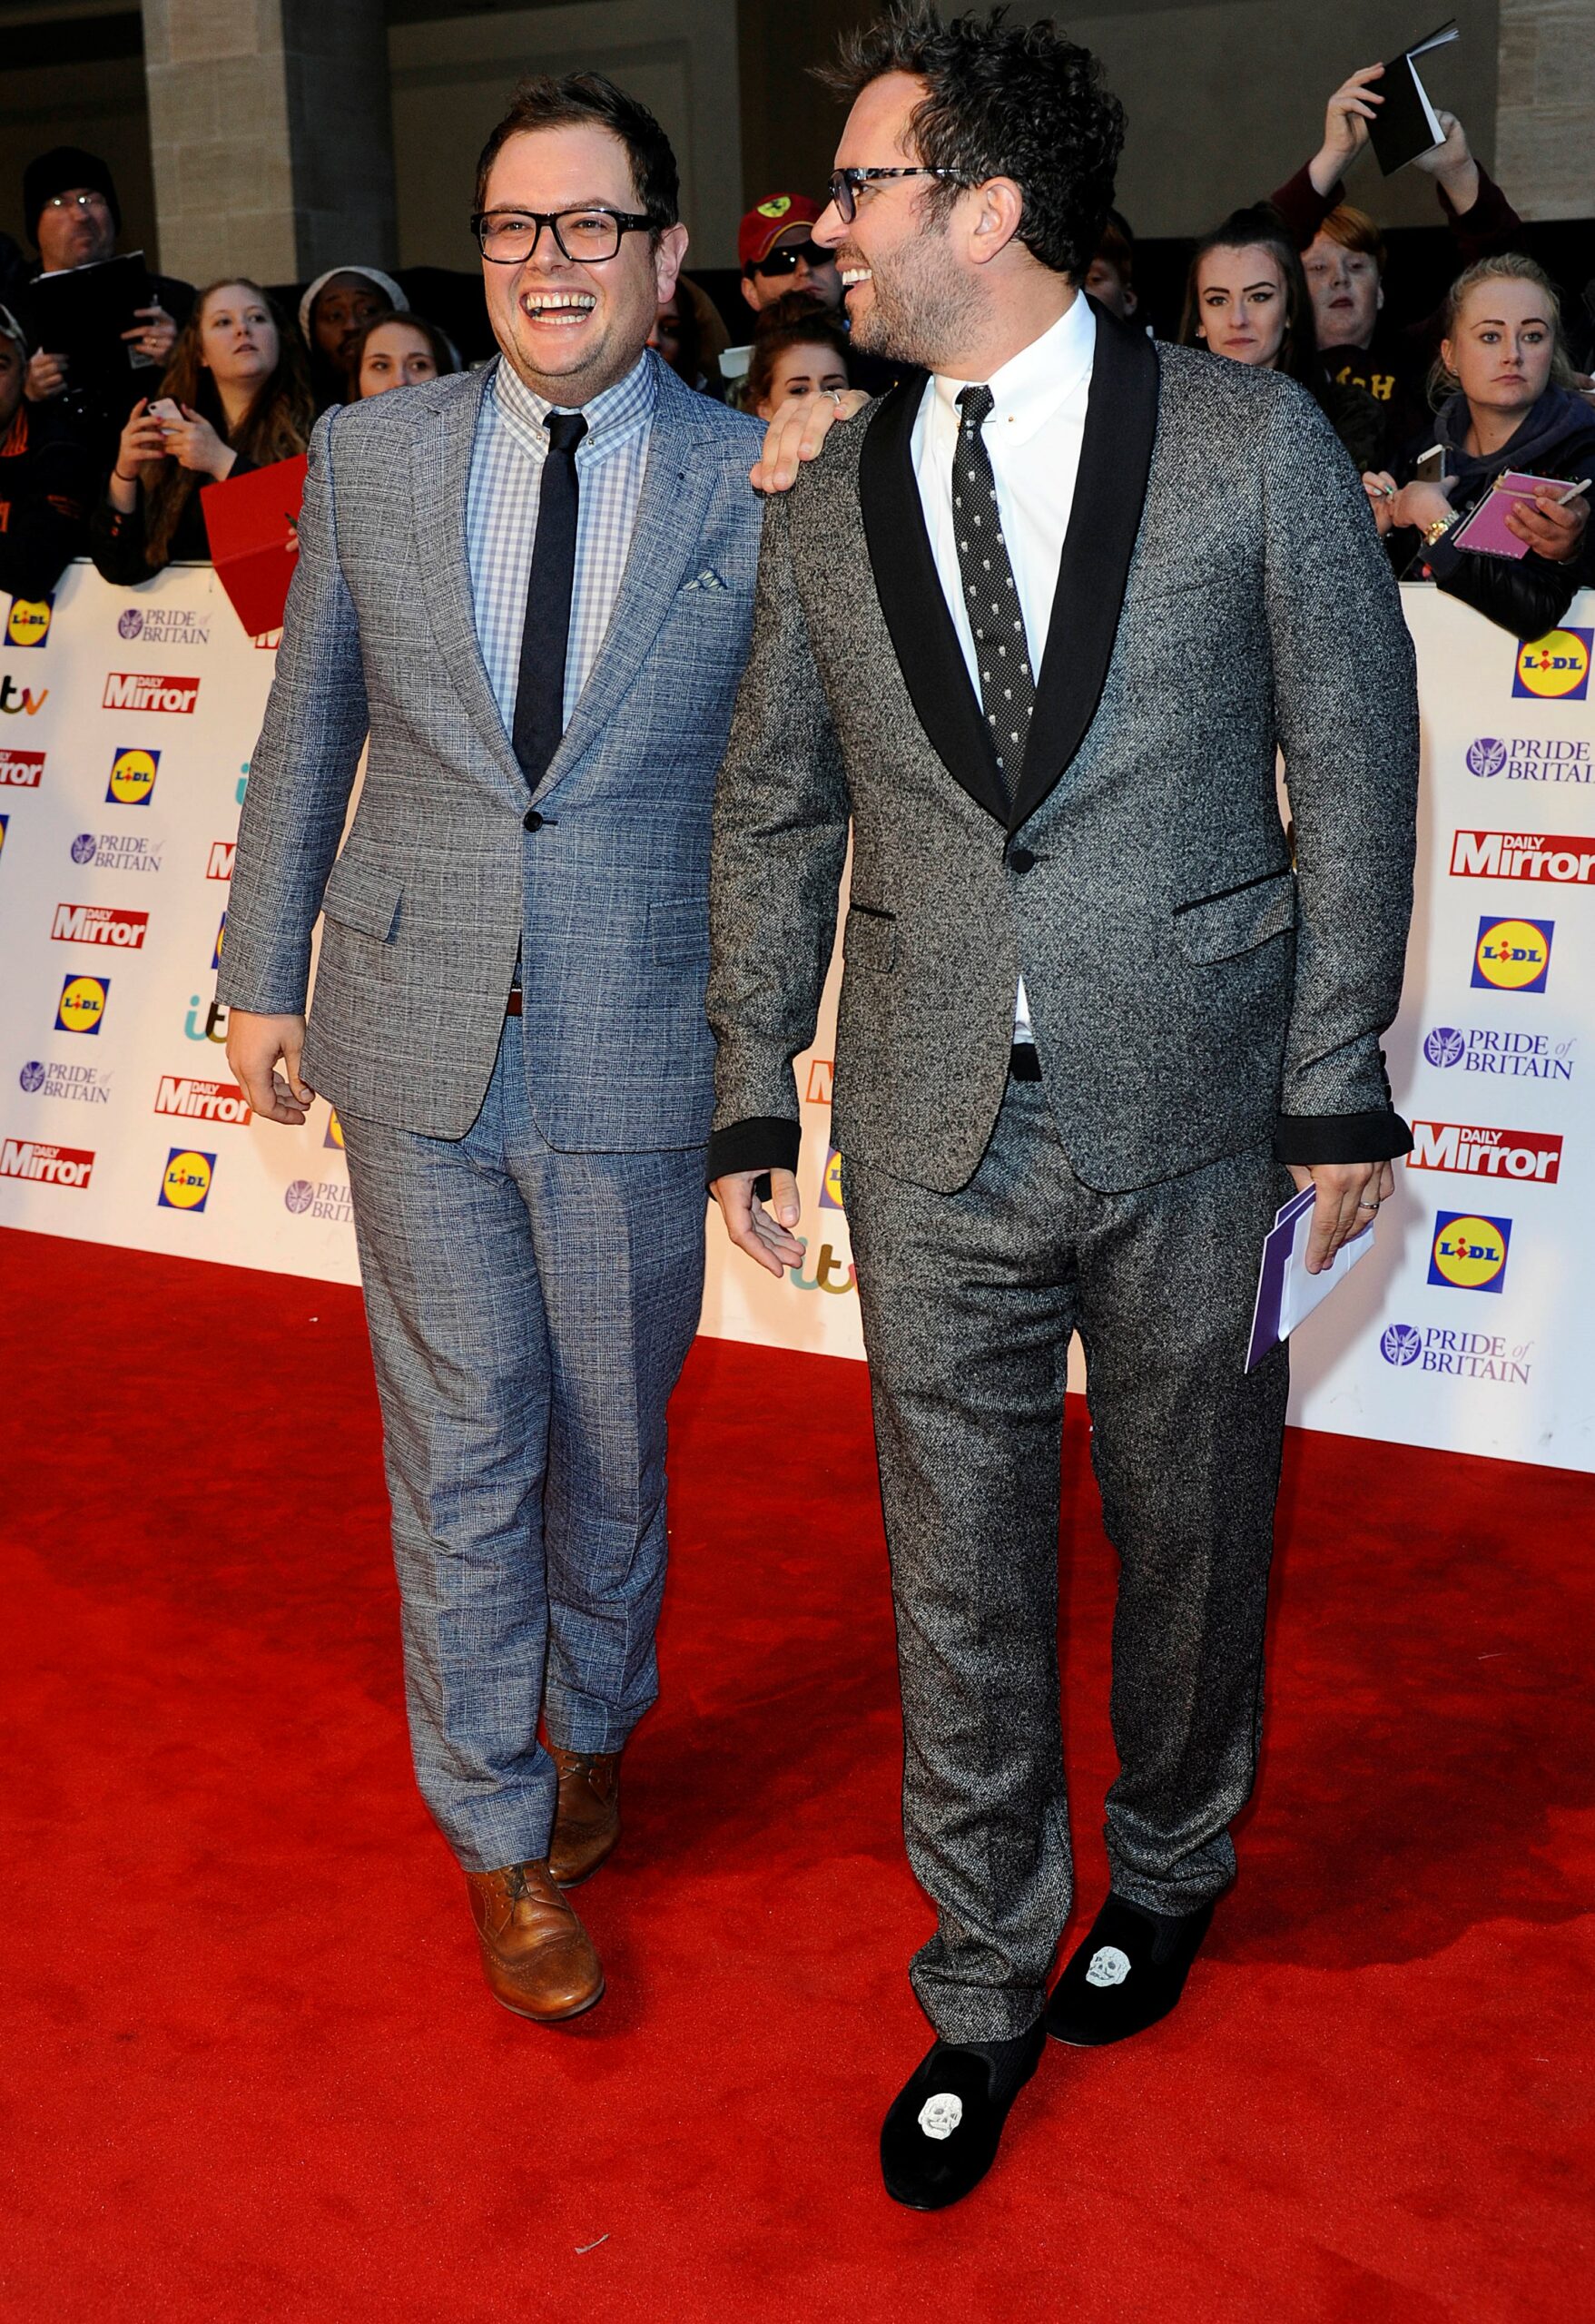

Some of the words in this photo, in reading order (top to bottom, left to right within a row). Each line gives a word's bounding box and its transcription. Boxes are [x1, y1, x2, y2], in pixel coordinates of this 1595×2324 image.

[145, 609, 196, 626] PRIDE
[142, 625, 210, 644] BRITAIN
[137, 676, 163, 687] DAILY
[0, 675, 49, 715] tv
[104, 675, 196, 712] Mirror
[1510, 739, 1590, 761] PRIDE
[1506, 761, 1595, 783] BRITAI
[98, 835, 149, 853] PRIDE
[1503, 835, 1544, 850] DAILY
[94, 852, 162, 872] BRITAIN
[53, 905, 145, 946] Mirror
[87, 909, 113, 921] DAILY
[184, 995, 228, 1044] it
[1467, 1029, 1549, 1055] PRIDE
[1554, 1038, 1577, 1059] of
[46, 1062, 97, 1084] PRIDE
[1463, 1053, 1574, 1080] BRITAIN
[43, 1080, 111, 1104] BRITAIN
[192, 1081, 220, 1095] DAILY
[155, 1077, 251, 1122] Mirror
[1461, 1128, 1502, 1145] DAILY
[34, 1145, 60, 1157] DAILY
[1409, 1123, 1558, 1179] Mirror
[0, 1140, 92, 1186] Mirror
[316, 1182, 352, 1203] PRI
[1423, 1327, 1506, 1357] PRIDE
[1511, 1340, 1535, 1363] of
[1421, 1352, 1531, 1385] BRITAIN
